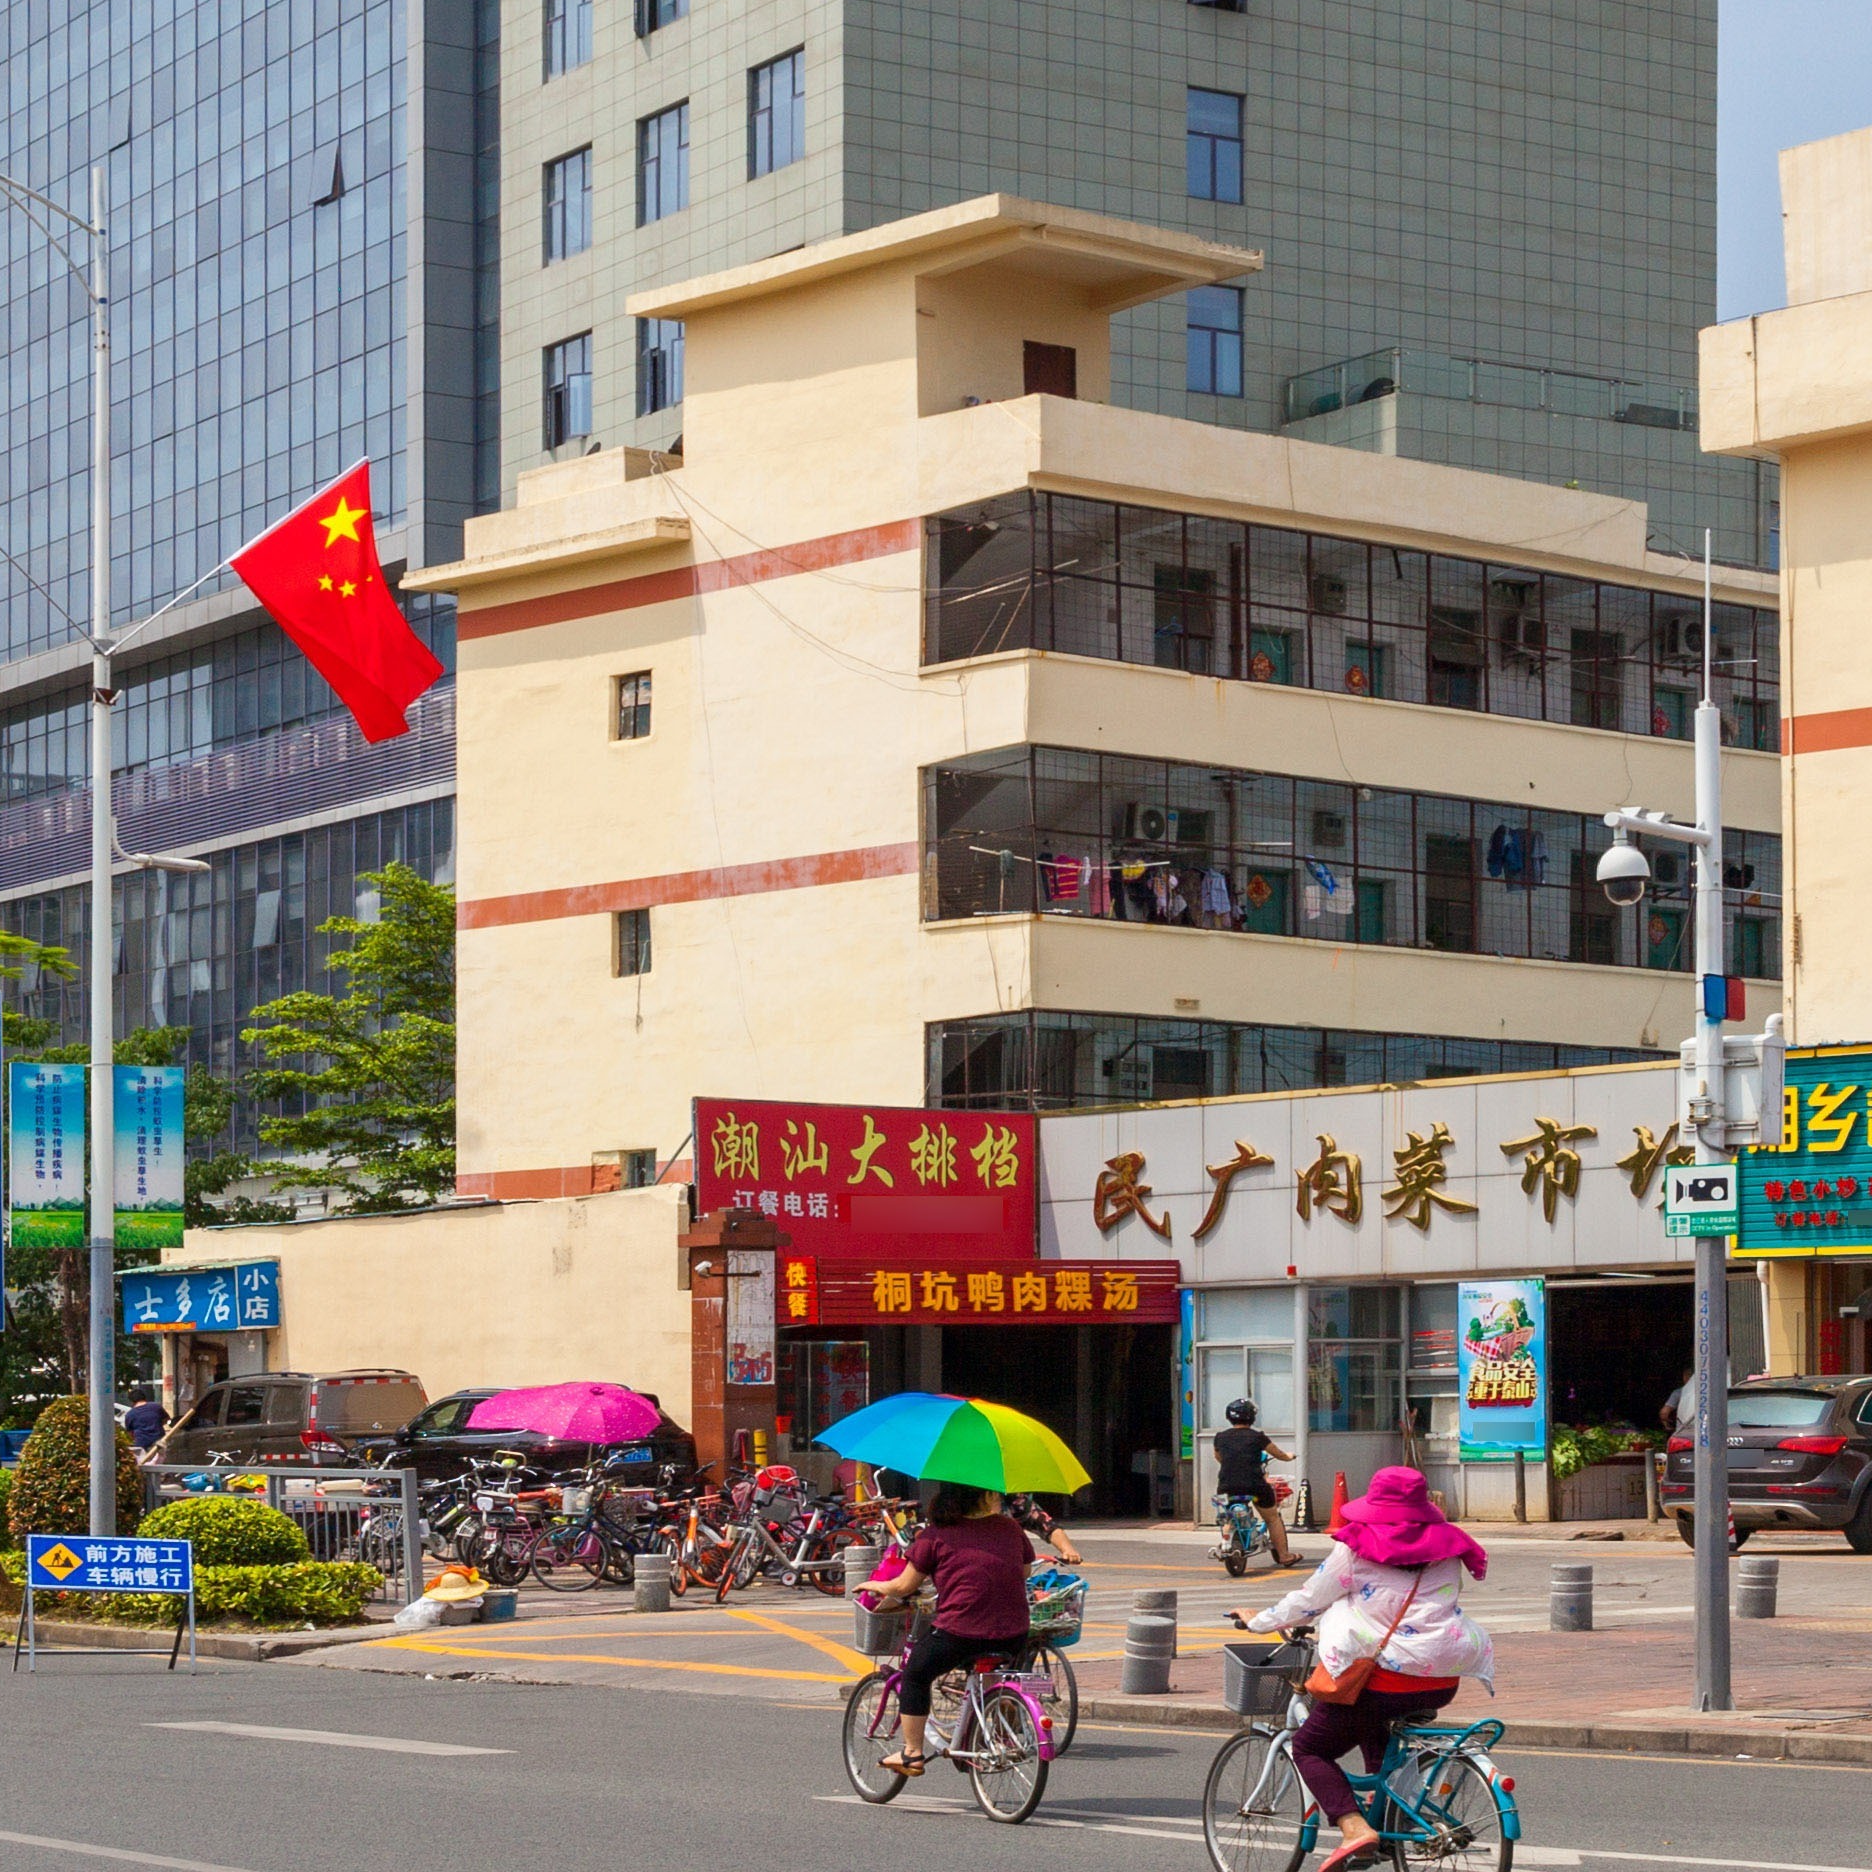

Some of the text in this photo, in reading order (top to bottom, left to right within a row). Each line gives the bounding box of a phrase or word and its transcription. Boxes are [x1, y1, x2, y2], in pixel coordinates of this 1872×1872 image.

[711, 1112, 1020, 1189] 潮汕大排档
[1764, 1177, 1857, 1202] 特色小炒
[134, 1276, 230, 1324] 士多店
[243, 1268, 270, 1320] 小店
[785, 1261, 809, 1318] 快餐
[872, 1270, 1140, 1313] 桐坑鸭肉粿汤
[1470, 1352, 1537, 1382] 食品安全
[1472, 1380, 1531, 1400] 重于泰山
[84, 1544, 183, 1564] 前方施工
[86, 1567, 183, 1587] 车辆慢行
